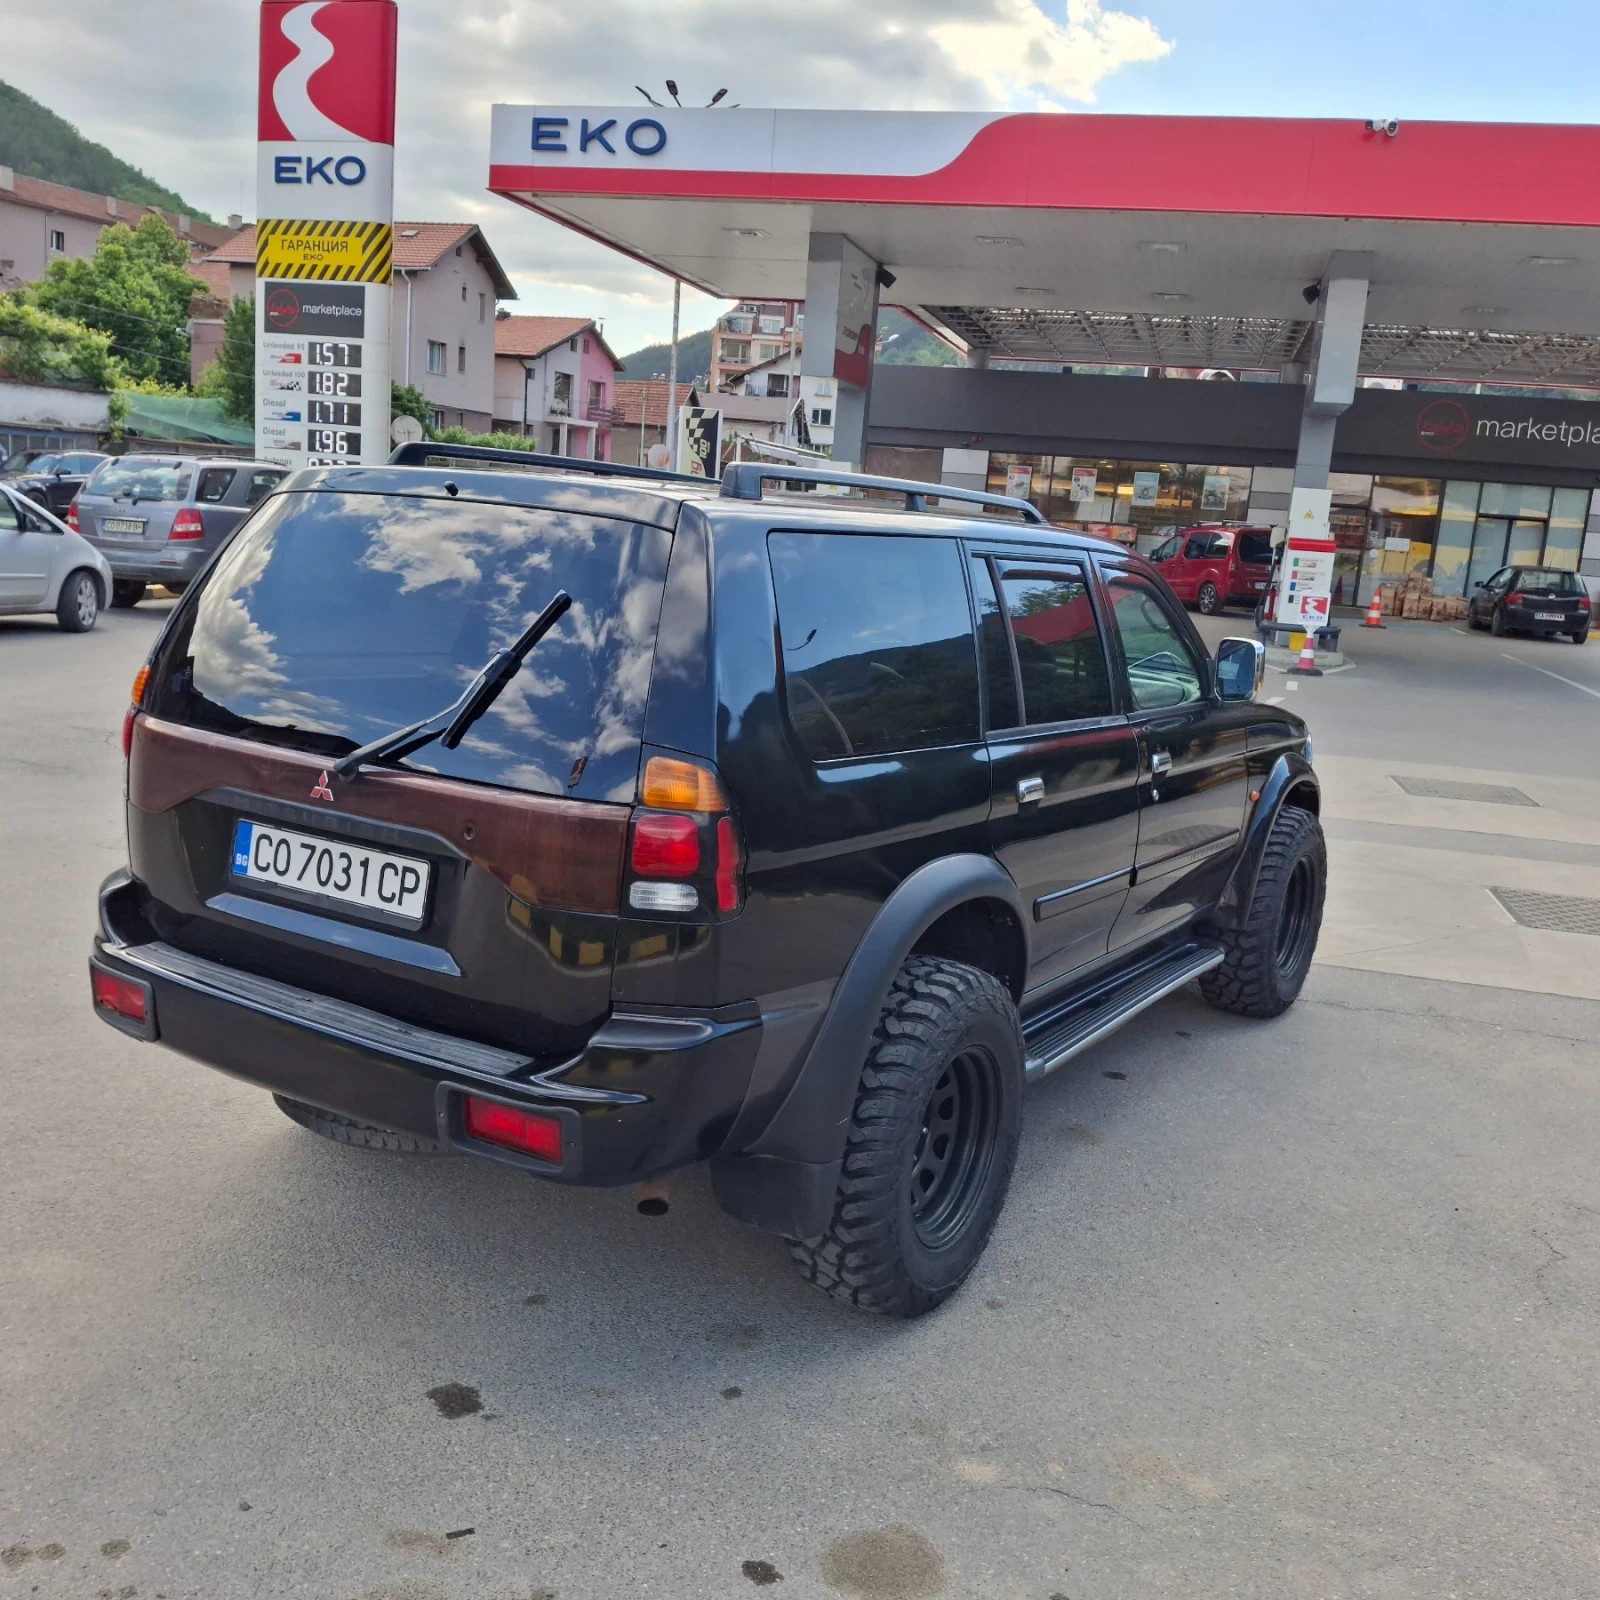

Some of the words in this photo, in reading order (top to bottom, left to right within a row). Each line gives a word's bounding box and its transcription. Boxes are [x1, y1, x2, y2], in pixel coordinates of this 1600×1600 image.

[531, 117, 667, 156] EKO
[274, 156, 366, 185] EKO
[281, 239, 349, 254] ГАРАНЦИЯ
[303, 253, 324, 261] EKO
[302, 304, 362, 317] marketplace
[262, 341, 295, 350] Unleaded
[316, 342, 349, 366] 1.57
[262, 369, 293, 378] Unleaded
[316, 372, 349, 396] 1.82
[262, 398, 286, 407] Diesel
[316, 401, 348, 424] 1.71
[262, 427, 286, 436] Diesel
[1476, 418, 1600, 447] marketpla
[315, 430, 348, 454] 1.96
[235, 853, 248, 867] BG
